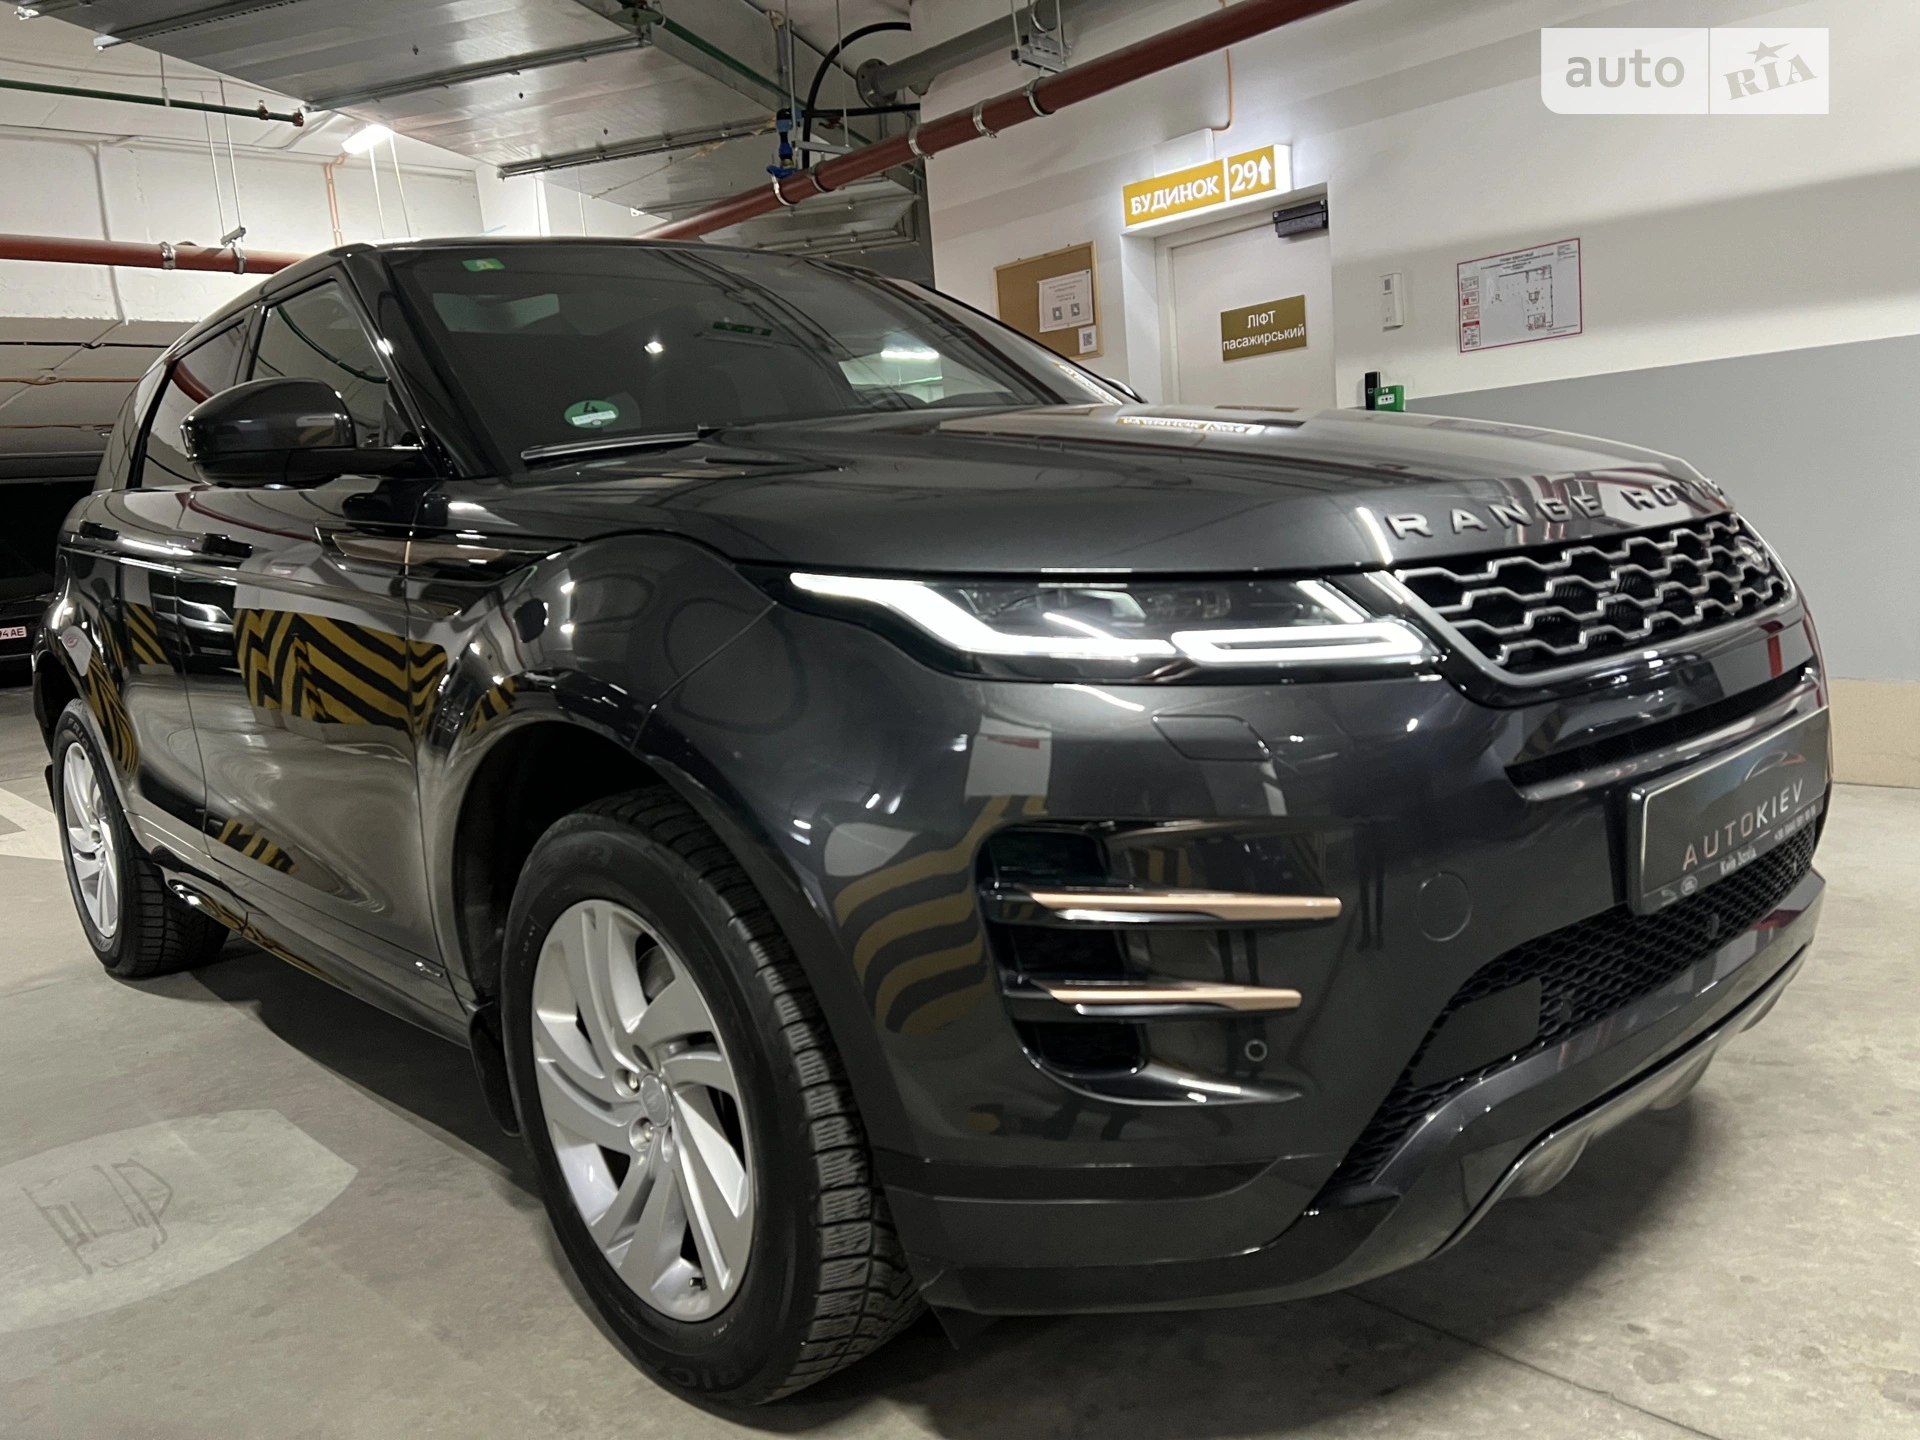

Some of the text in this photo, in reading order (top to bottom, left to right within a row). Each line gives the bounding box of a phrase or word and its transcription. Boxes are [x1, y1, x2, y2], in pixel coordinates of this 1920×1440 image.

[1130, 160, 1258, 216] БУДИНОК 29
[1222, 323, 1306, 352] пасажирський
[1247, 310, 1277, 329] ЛІФТ
[1385, 494, 1607, 540] RANGE
[1682, 778, 1803, 871] AUTOKIEV
